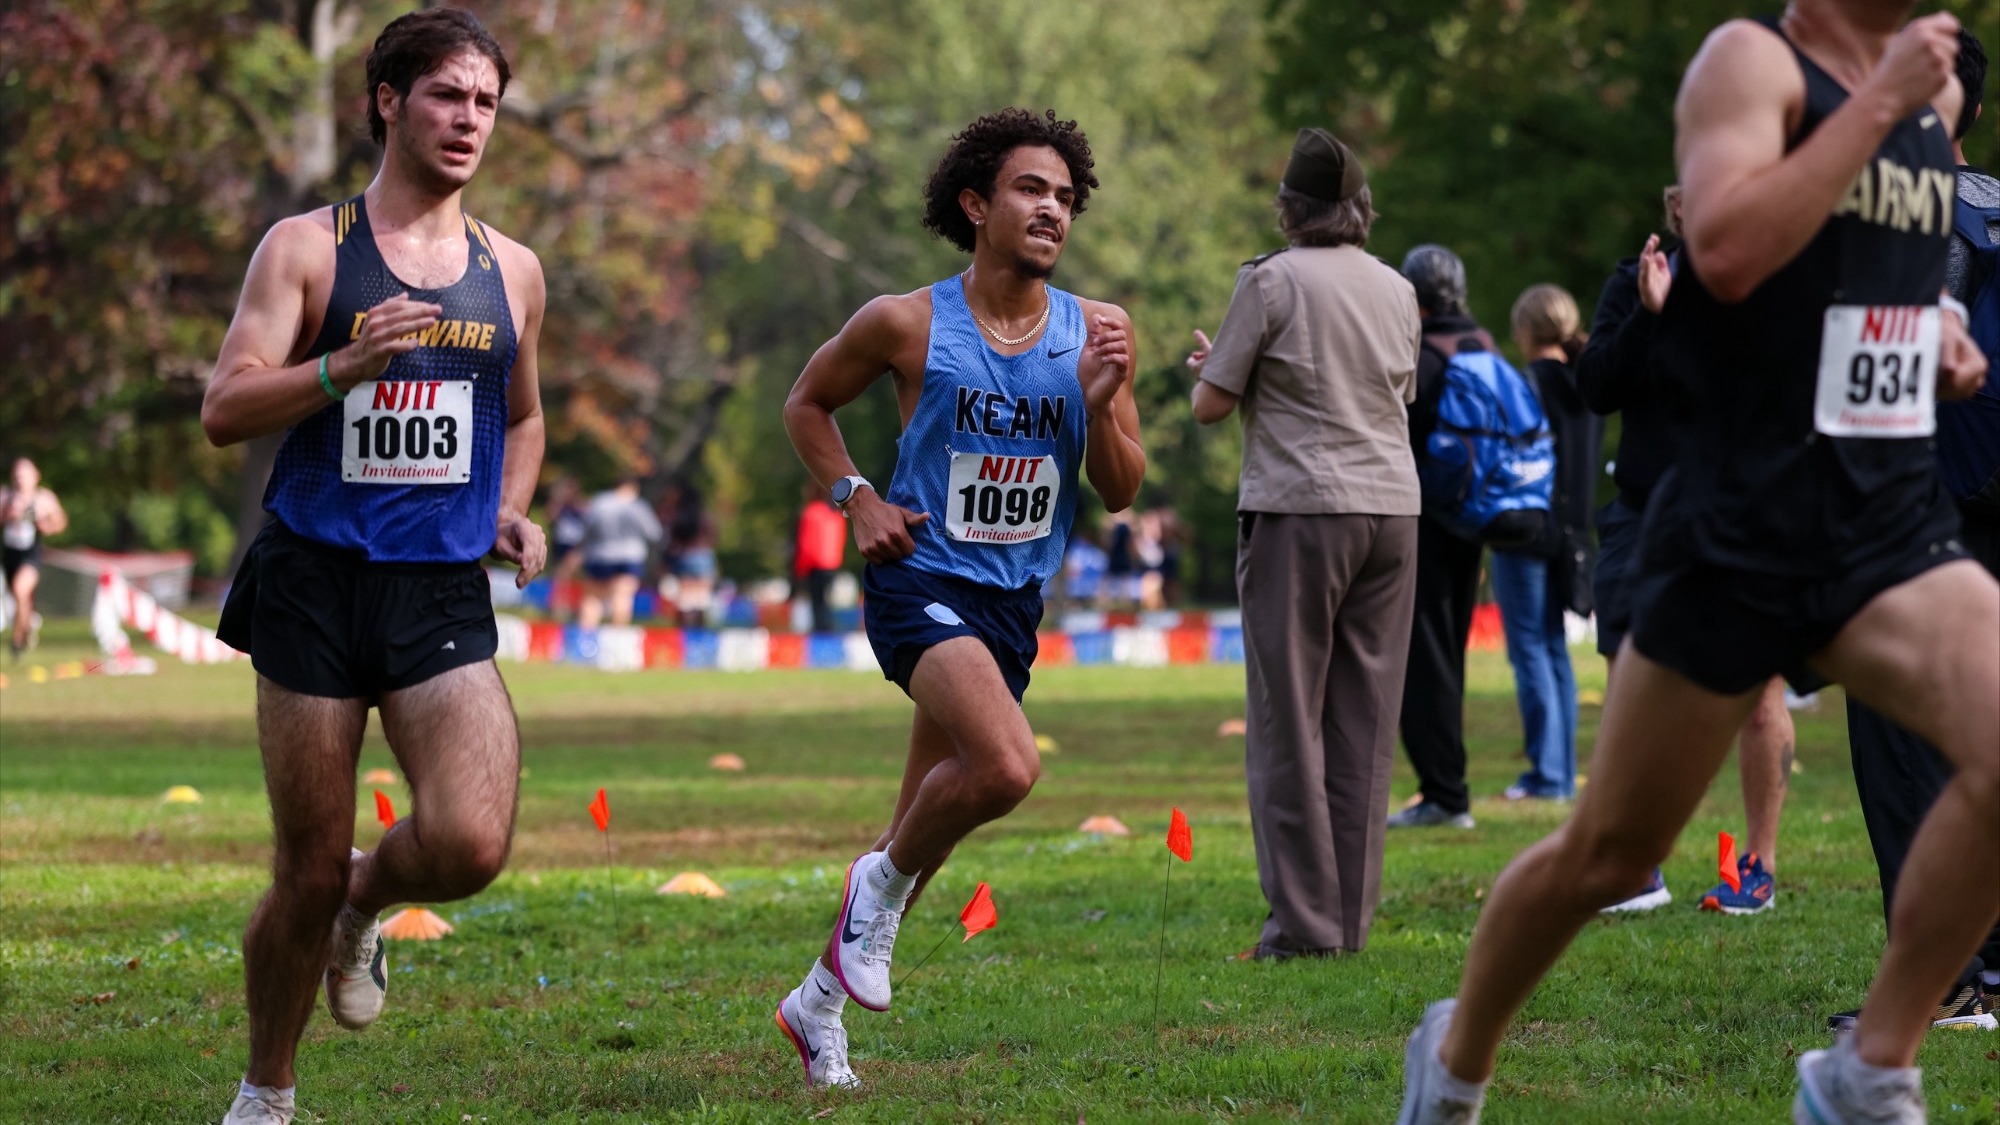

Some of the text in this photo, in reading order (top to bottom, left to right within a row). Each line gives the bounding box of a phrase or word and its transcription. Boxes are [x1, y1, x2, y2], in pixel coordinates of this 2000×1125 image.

[1832, 157, 1954, 238] ARMY
[351, 313, 495, 350] DWARE
[371, 381, 442, 413] NJIT
[1847, 353, 1922, 404] 934
[955, 386, 1065, 441] KEAN
[352, 416, 457, 460] 1003
[361, 463, 450, 478] Invitational
[978, 456, 1044, 485] NJIT
[959, 484, 1050, 526] 1098
[965, 525, 1039, 541] Invitational
